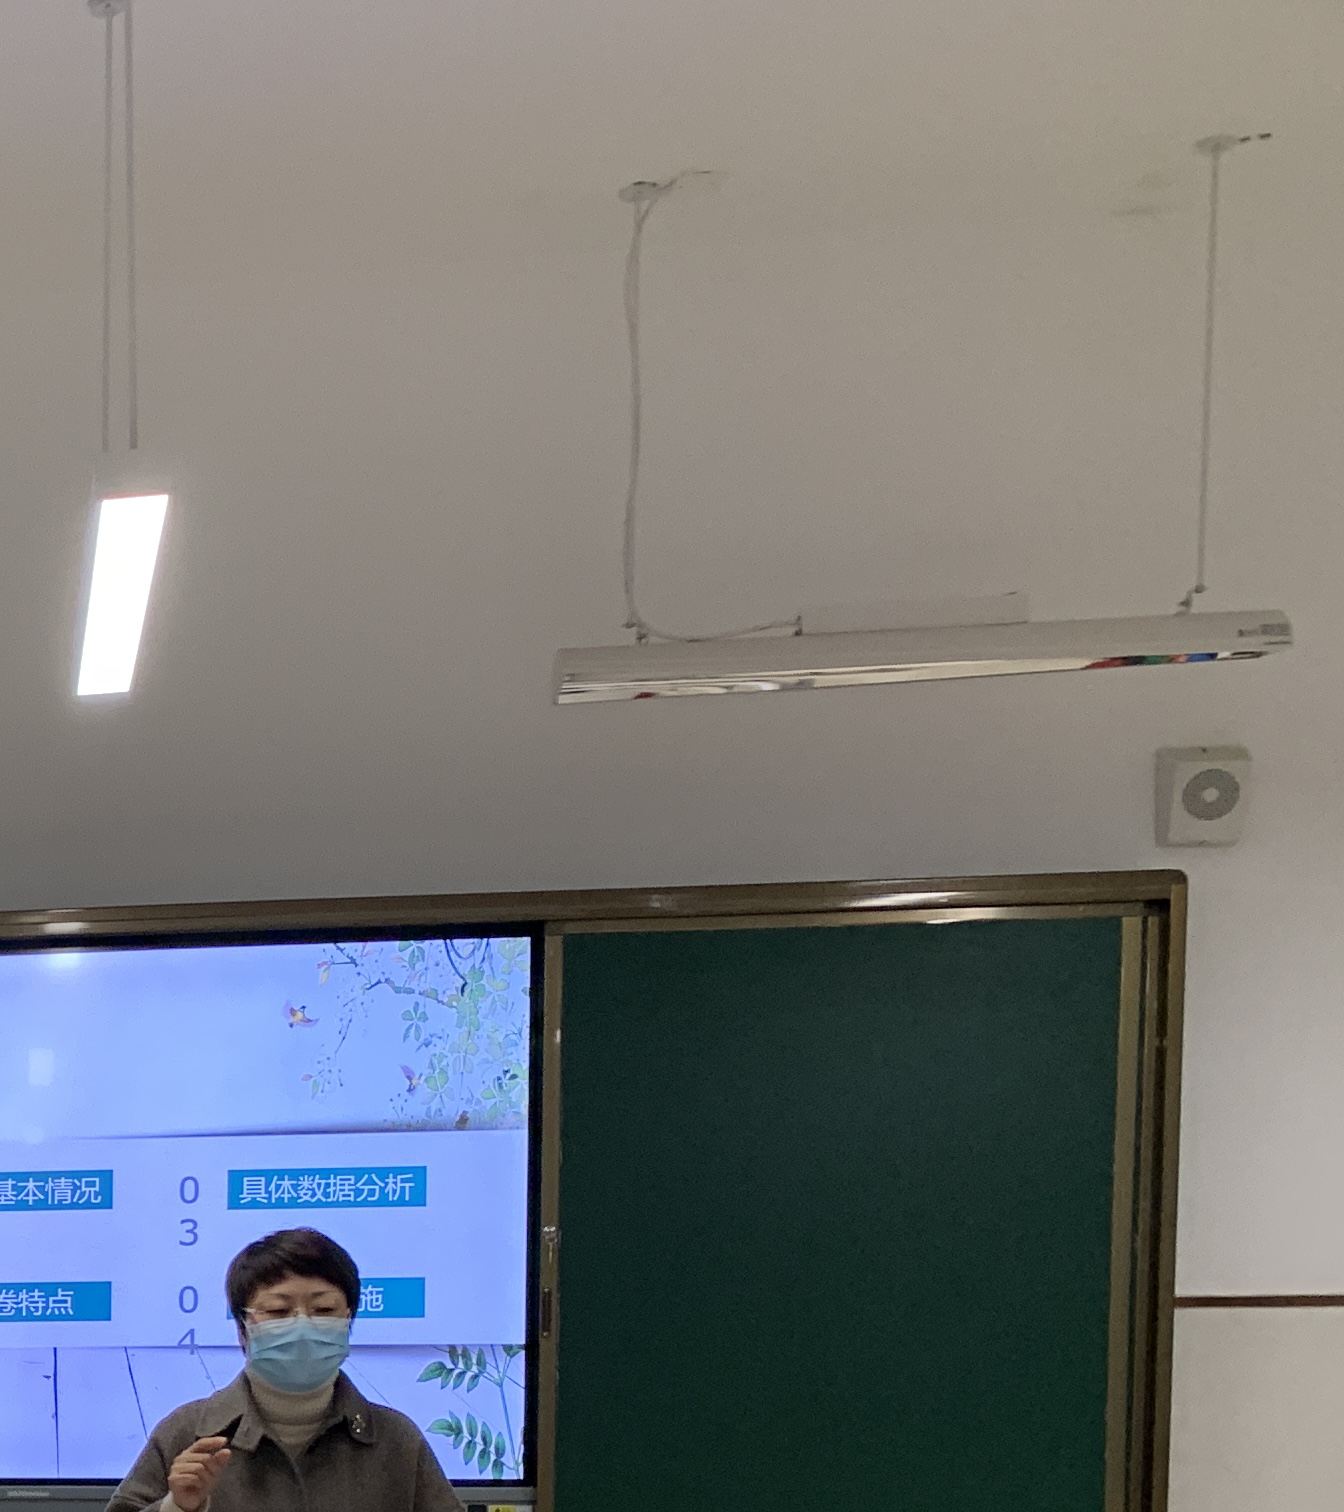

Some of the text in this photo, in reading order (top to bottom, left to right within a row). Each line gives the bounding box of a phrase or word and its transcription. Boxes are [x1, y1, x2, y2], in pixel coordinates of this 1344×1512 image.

[239, 1173, 415, 1204] 具体数据分析
